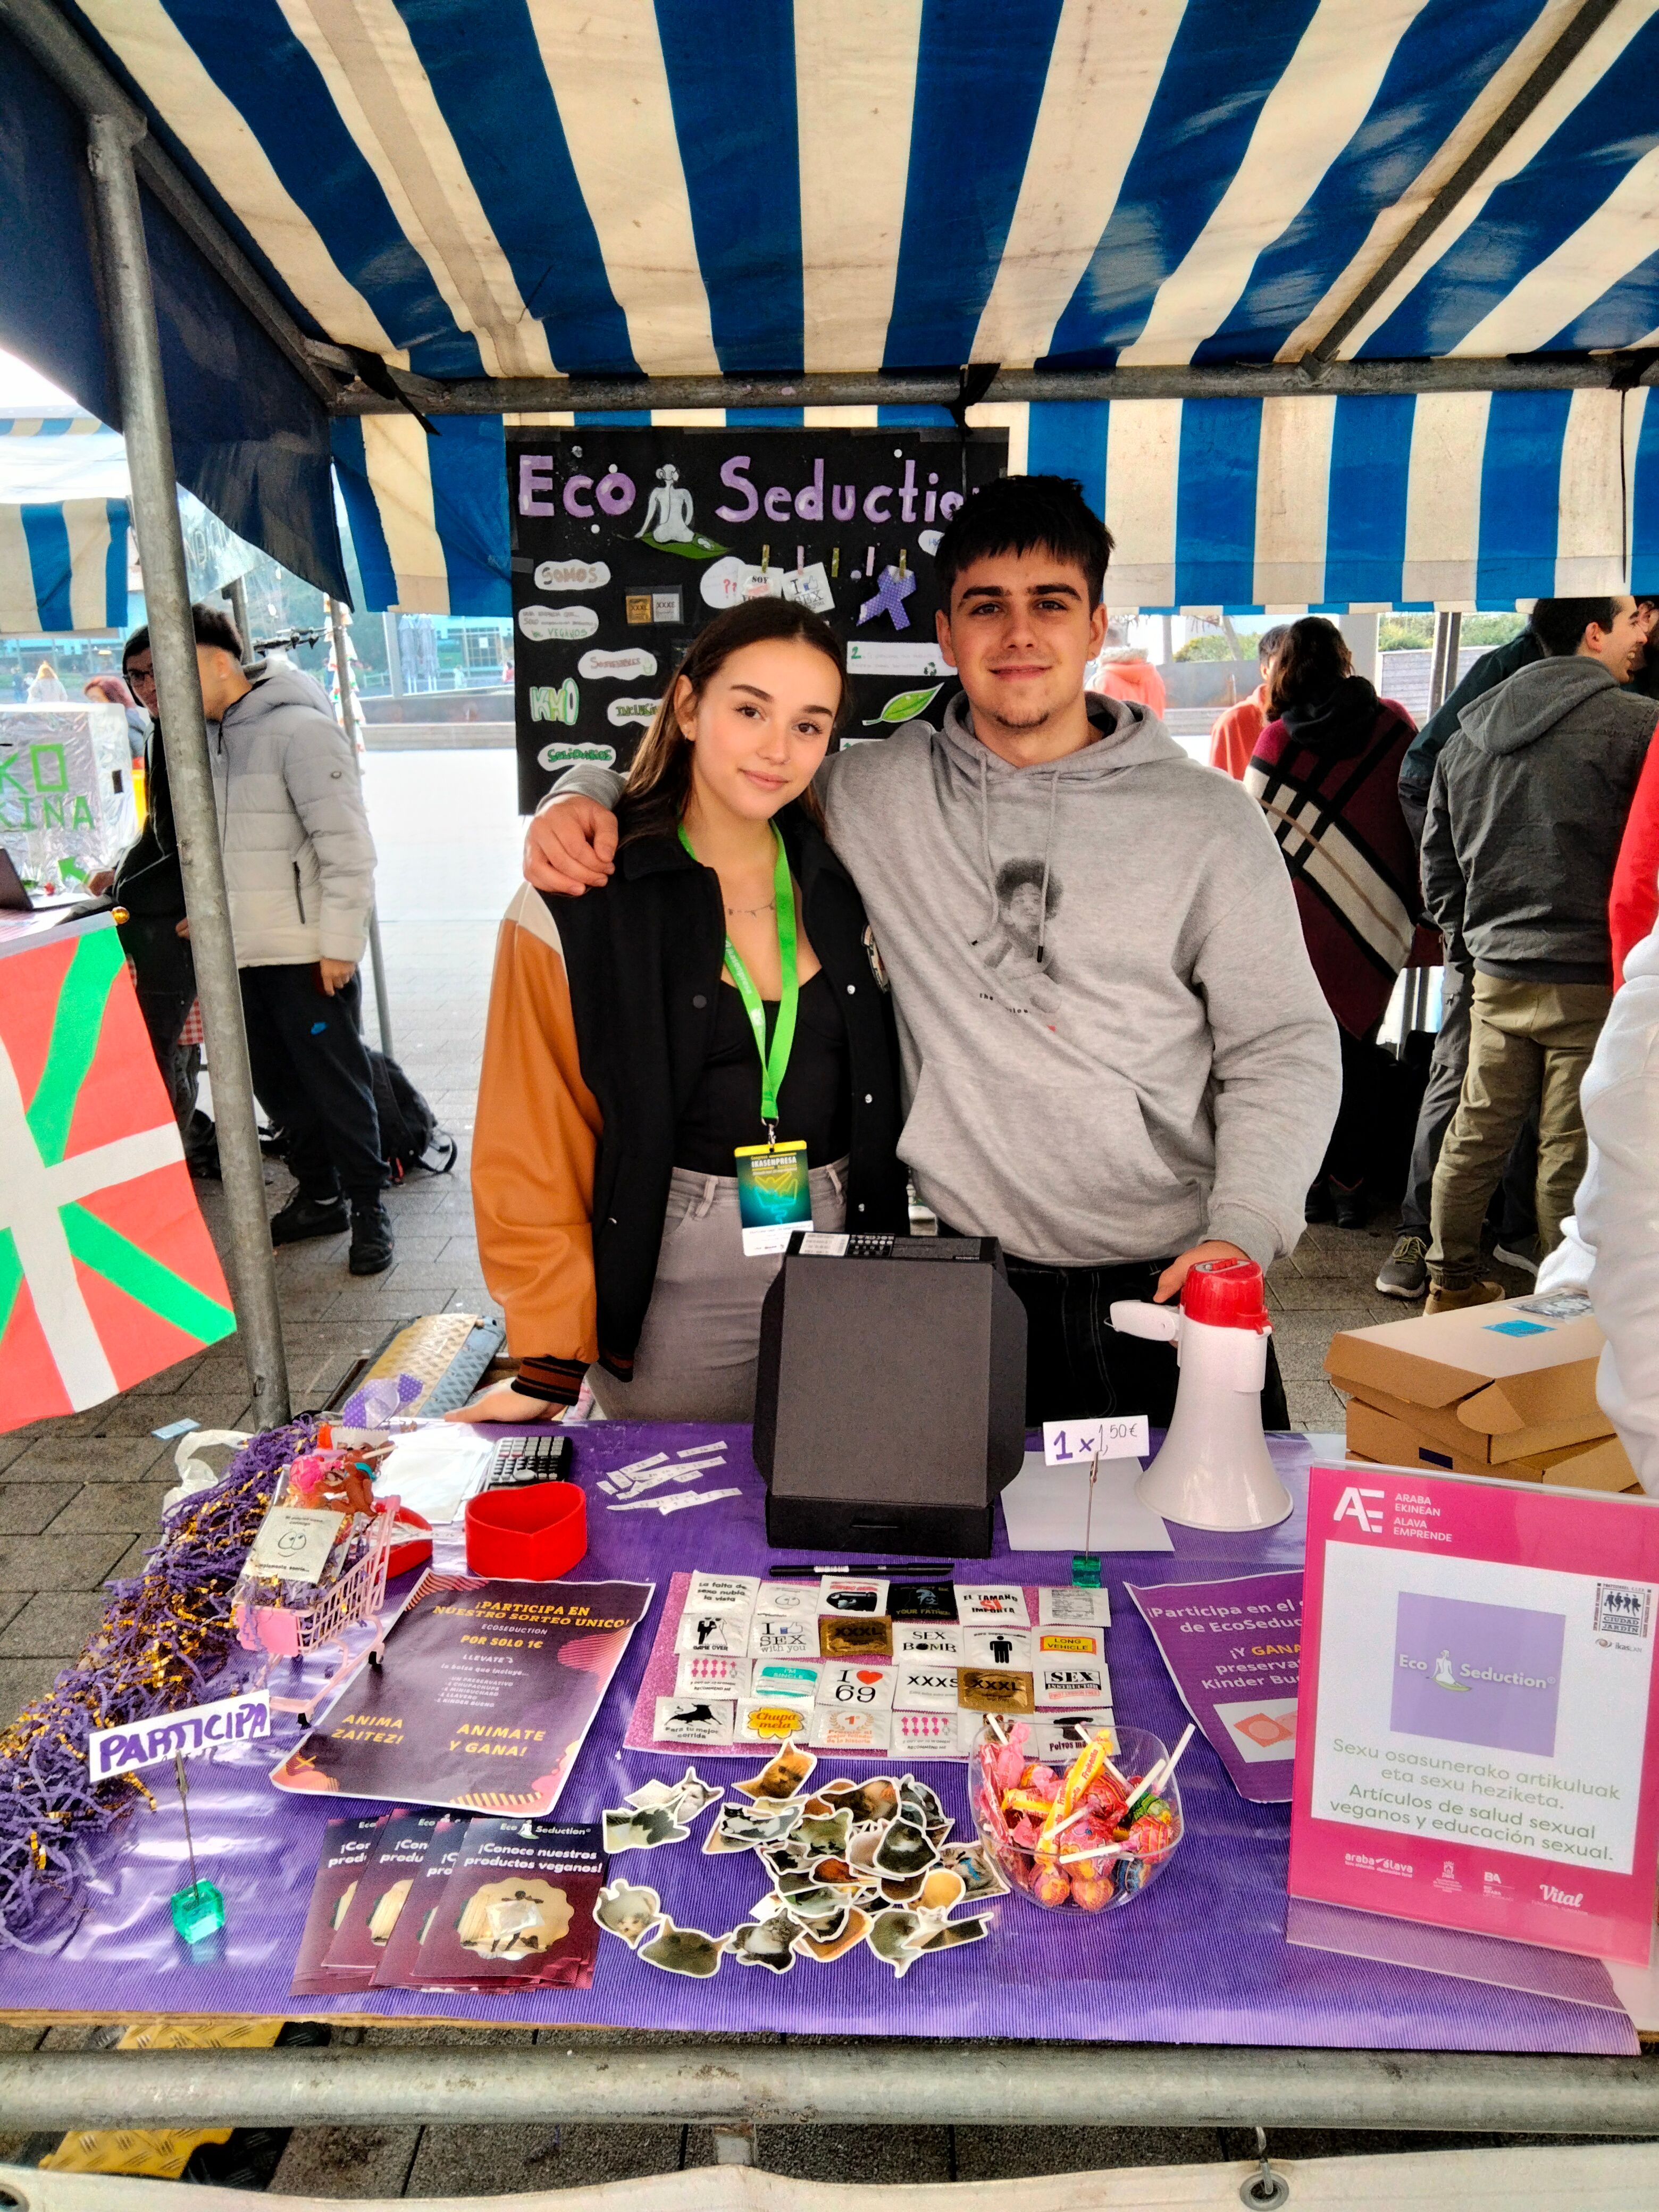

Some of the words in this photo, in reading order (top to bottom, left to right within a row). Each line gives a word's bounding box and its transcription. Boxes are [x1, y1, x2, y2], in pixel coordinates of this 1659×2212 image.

[520, 454, 636, 518] Eco
[715, 455, 979, 523] Seductio
[751, 1156, 797, 1168] IKASENPRESA
[1053, 1430, 1073, 1460] 1
[1395, 1493, 1431, 1505] ARABA
[1395, 1503, 1440, 1516] EKINEAN
[1393, 1517, 1427, 1529] ALAVA
[1393, 1527, 1453, 1542] EMPRENDE
[568, 1606, 591, 1616] EN
[1247, 1603, 1272, 1613] en
[1277, 1599, 1295, 1612] el
[432, 1606, 507, 1619] NUESTRO
[508, 1613, 572, 1626] SORTEO
[1603, 1616, 1638, 1625] CIUDAD
[481, 1623, 548, 1635] ECOSEDUCTION
[761, 1622, 775, 1635] I
[835, 1627, 881, 1637] XXXL
[1180, 1622, 1205, 1633] de
[460, 1635, 487, 1645] POR
[490, 1638, 523, 1648] SOLO
[760, 1635, 807, 1647] SEX
[912, 1631, 946, 1640] SEX
[761, 1644, 784, 1653] with
[786, 1644, 806, 1653] you
[463, 1654, 505, 1663] LLEVATE
[1398, 1653, 1428, 1670] Eco
[463, 1677, 514, 1687] PRESERVATIVO
[837, 1669, 853, 1683] I
[1051, 1671, 1094, 1682] SEX
[971, 1679, 1025, 1691] XXXL
[1202, 1677, 1264, 1689] Kinder
[835, 1685, 876, 1703] 69
[341, 1714, 403, 1729] ANIMA
[756, 1712, 797, 1723] Chupa
[759, 1720, 791, 1728] mela
[331, 1728, 404, 1745] ZAITEZ!
[456, 1723, 547, 1742] ANIMATE
[449, 1740, 462, 1752] Y
[465, 1741, 529, 1757] GANA!
[1049, 1741, 1074, 1752] Polvos
[1333, 1738, 1379, 1759] Sexu
[1385, 1750, 1510, 1780] osasunerako
[1516, 1772, 1621, 1800] artikuluak
[1381, 1768, 1414, 1783] eta
[1420, 1775, 1464, 1792] sexu
[1471, 1780, 1564, 1809] heziketa.
[1349, 1784, 1432, 1809] Artículos
[1439, 1800, 1464, 1815] de
[1469, 1807, 1523, 1825] salud
[1529, 1817, 1596, 1839] sexual
[1330, 1800, 1410, 1824] veganos
[1416, 1815, 1427, 1829] y
[1432, 1819, 1535, 1846] educación
[1541, 1838, 1613, 1861] sexual.
[537, 1848, 597, 1860] nuestros
[1345, 1853, 1375, 1865] araba
[464, 1856, 535, 1869] productos
[539, 1862, 603, 1874] veganos!
[1539, 1884, 1583, 1907] Vital
